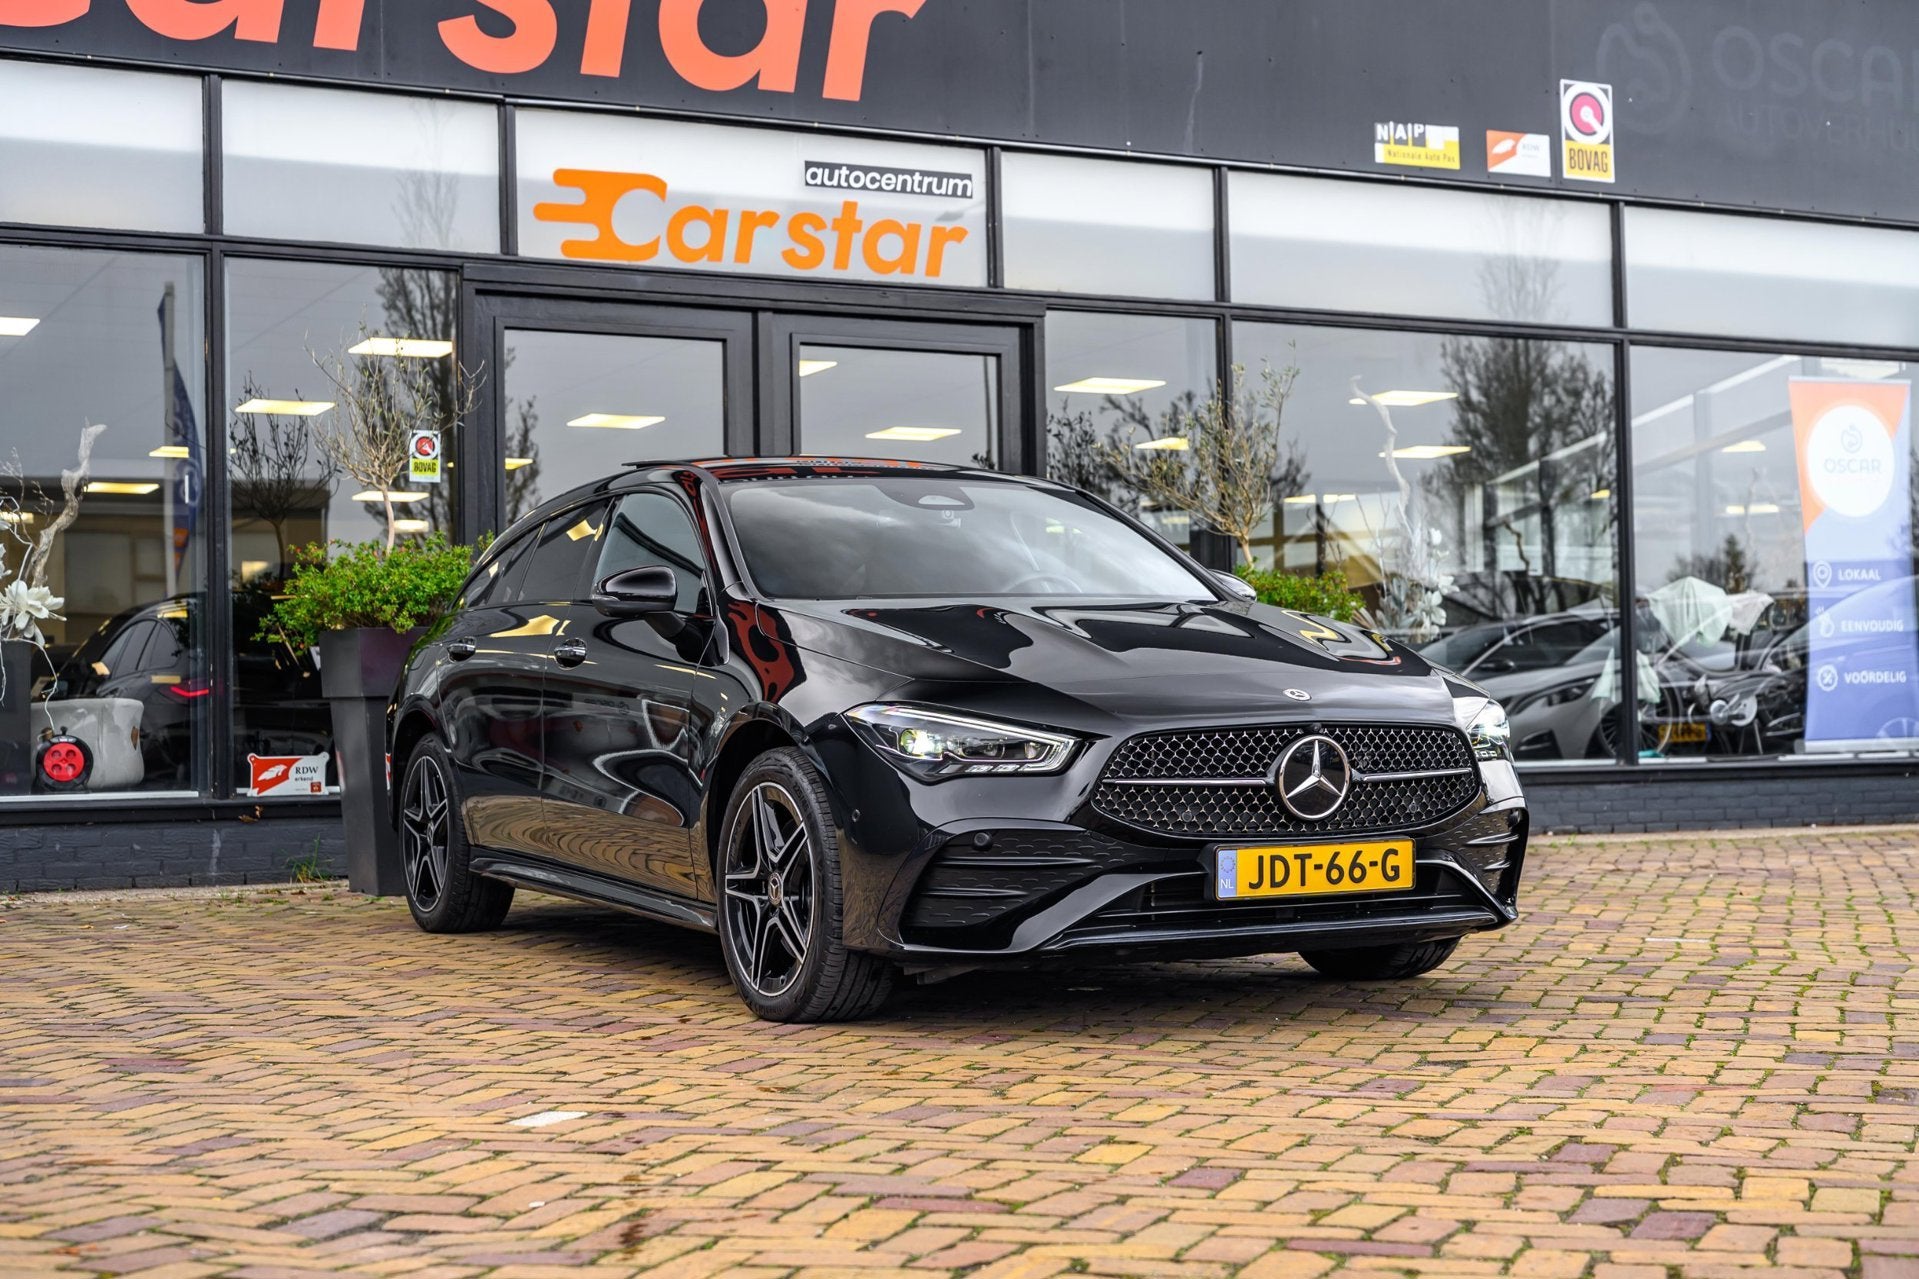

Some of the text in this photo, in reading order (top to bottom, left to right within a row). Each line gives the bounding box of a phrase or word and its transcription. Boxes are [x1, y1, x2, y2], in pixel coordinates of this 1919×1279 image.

[1713, 25, 1919, 113] OSCA
[1569, 148, 1608, 172] BOVAG
[806, 162, 973, 197] autocentrum
[533, 168, 969, 277] Carstar
[413, 462, 437, 473] BOVAG
[1824, 457, 1882, 474] OSCAR
[1838, 568, 1881, 581] LOKAAL
[1841, 619, 1904, 632] EENVOUDIG
[295, 766, 319, 775] RDW
[1248, 848, 1400, 890] JDT-66-G
[1220, 878, 1234, 889] NL
